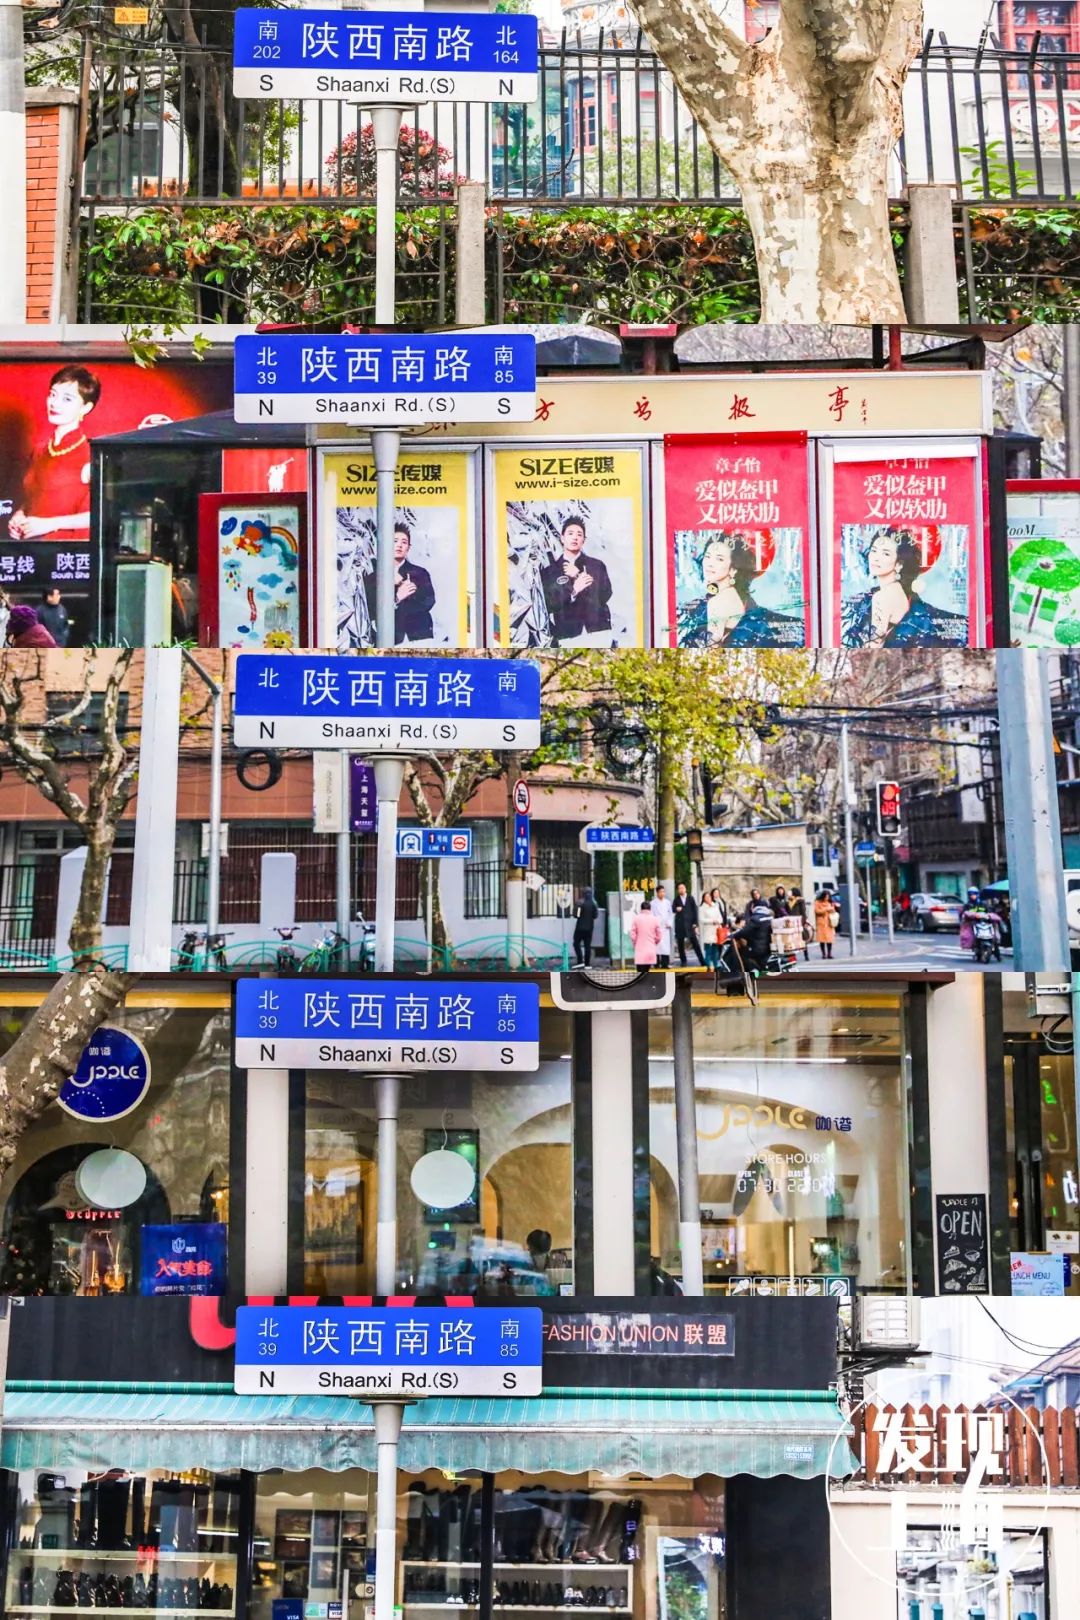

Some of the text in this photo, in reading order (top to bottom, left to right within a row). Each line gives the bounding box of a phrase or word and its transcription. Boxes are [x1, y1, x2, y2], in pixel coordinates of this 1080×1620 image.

[258, 20, 279, 41] 南
[495, 25, 517, 46] 北
[302, 21, 474, 62] 陕西南路
[253, 45, 281, 59] 202
[492, 50, 520, 64] 164
[259, 74, 274, 91] S
[316, 76, 455, 94] Shaanxi Rd.(S)
[498, 79, 513, 96] N
[256, 346, 278, 366] 北
[301, 345, 471, 383] 陕西南路
[494, 345, 514, 366] 南
[257, 371, 277, 385] 39
[494, 370, 514, 384] 85
[258, 399, 274, 416] N
[315, 397, 456, 413] Shaanxi Rd.(S)
[497, 397, 511, 414] S
[519, 456, 615, 476] SIZE传媒
[715, 457, 761, 474] 章子怡
[515, 478, 620, 488] www.i-size.com
[695, 479, 778, 501] 爱似盔甲
[862, 474, 946, 496] 爱似盔甲
[696, 501, 780, 525] 又似软肋
[863, 497, 947, 519] 又似软肋
[0, 556, 35, 574] 号线
[56, 553, 90, 571] 陕西
[258, 667, 279, 688] 北
[498, 670, 517, 692] 南
[302, 667, 475, 707] 陕西南路
[260, 721, 275, 739] N
[322, 723, 458, 739] Shaanxi Rd.(S)
[502, 725, 516, 742] S
[258, 990, 279, 1010] 北
[497, 993, 517, 1014] 南
[304, 991, 476, 1031] 陕西南路
[258, 1015, 278, 1029] 39
[497, 1019, 516, 1033] 85
[260, 1044, 275, 1061] N
[319, 1046, 457, 1064] Shaanxi Rd.(S)
[500, 1048, 514, 1064] S
[815, 1116, 852, 1132] 咖谱
[745, 1153, 826, 1164] STORE HOURS
[940, 1210, 982, 1237] OPEN
[257, 1318, 279, 1338] 北
[303, 1318, 476, 1356] 陕西南路
[500, 1319, 520, 1340] 南
[621, 1326, 678, 1343] UNION
[684, 1324, 727, 1345] 联盟
[258, 1342, 277, 1356] 39
[500, 1344, 519, 1357] 85
[260, 1371, 275, 1388] N
[318, 1372, 458, 1389] Shaanxi Rd.(S)
[503, 1372, 517, 1389] S
